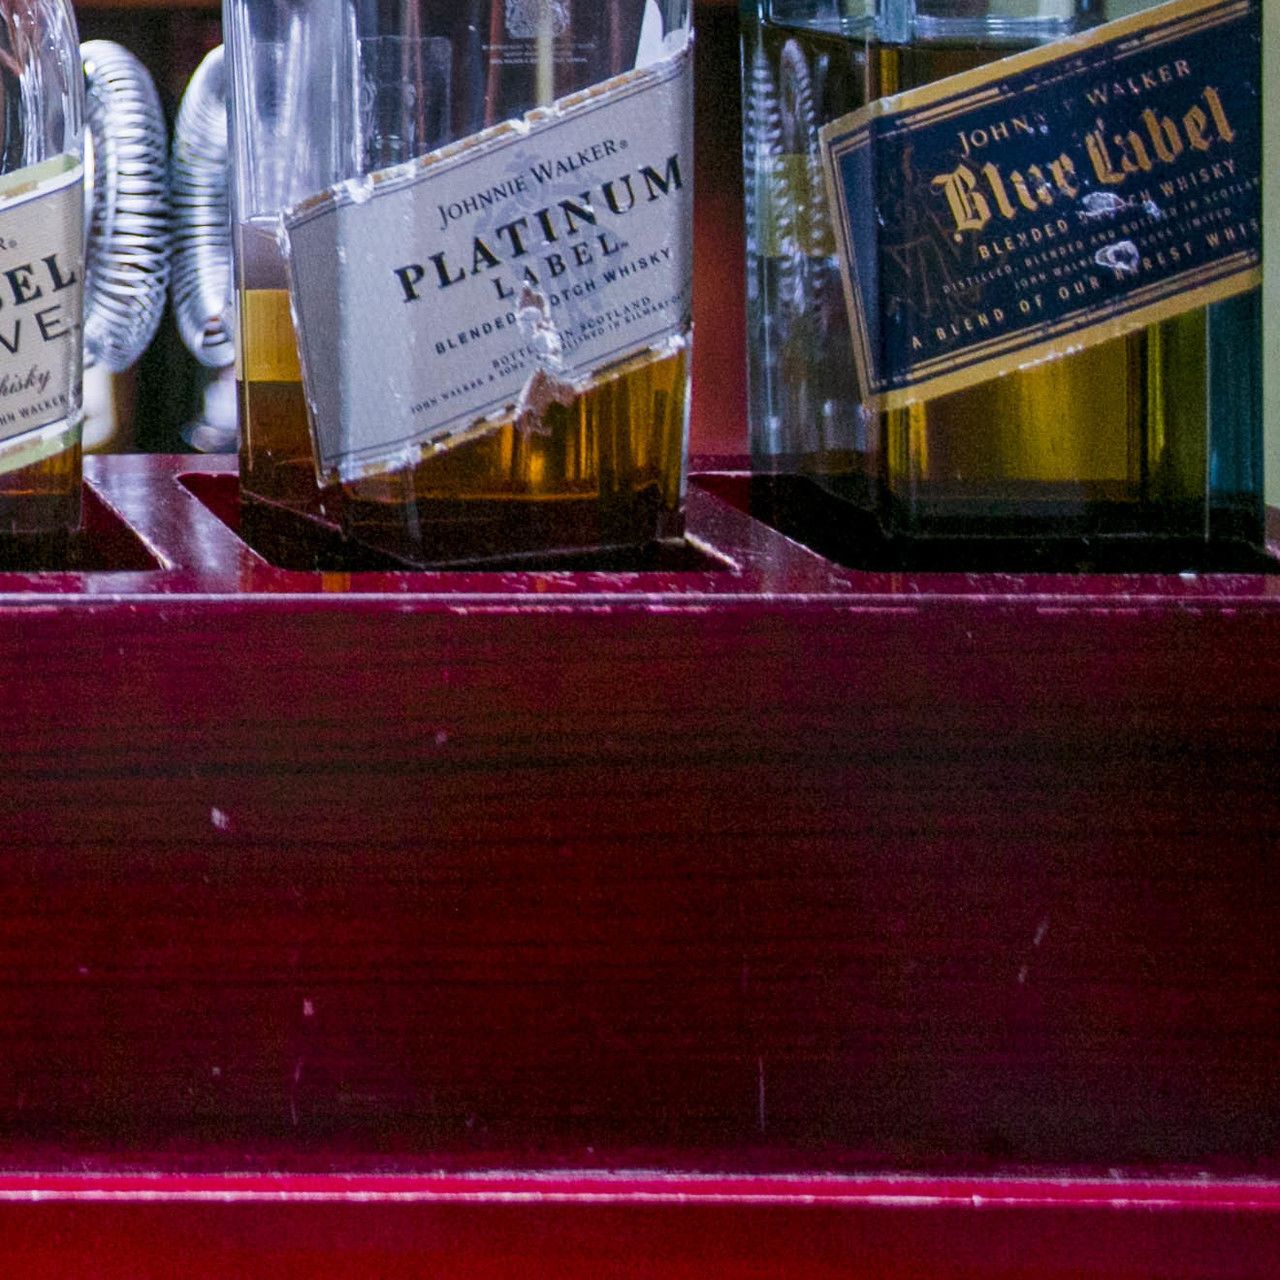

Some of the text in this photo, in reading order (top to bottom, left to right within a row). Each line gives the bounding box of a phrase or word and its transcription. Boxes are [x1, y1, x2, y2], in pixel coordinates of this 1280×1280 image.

[1086, 59, 1191, 106] WALKER
[1084, 85, 1236, 185] Label
[393, 153, 683, 303] PLATINUM
[437, 174, 528, 231] JOHNNIE
[977, 219, 1069, 260] BLENDED
[1159, 158, 1236, 198] WHISKY
[434, 311, 517, 355] BLENDED
[602, 247, 671, 283] WHISKY
[911, 335, 922, 350] A
[935, 308, 1005, 341] BLEND
[1019, 294, 1043, 314] OF
[1057, 276, 1100, 300] OUR
[19, 393, 68, 419] WALKER
